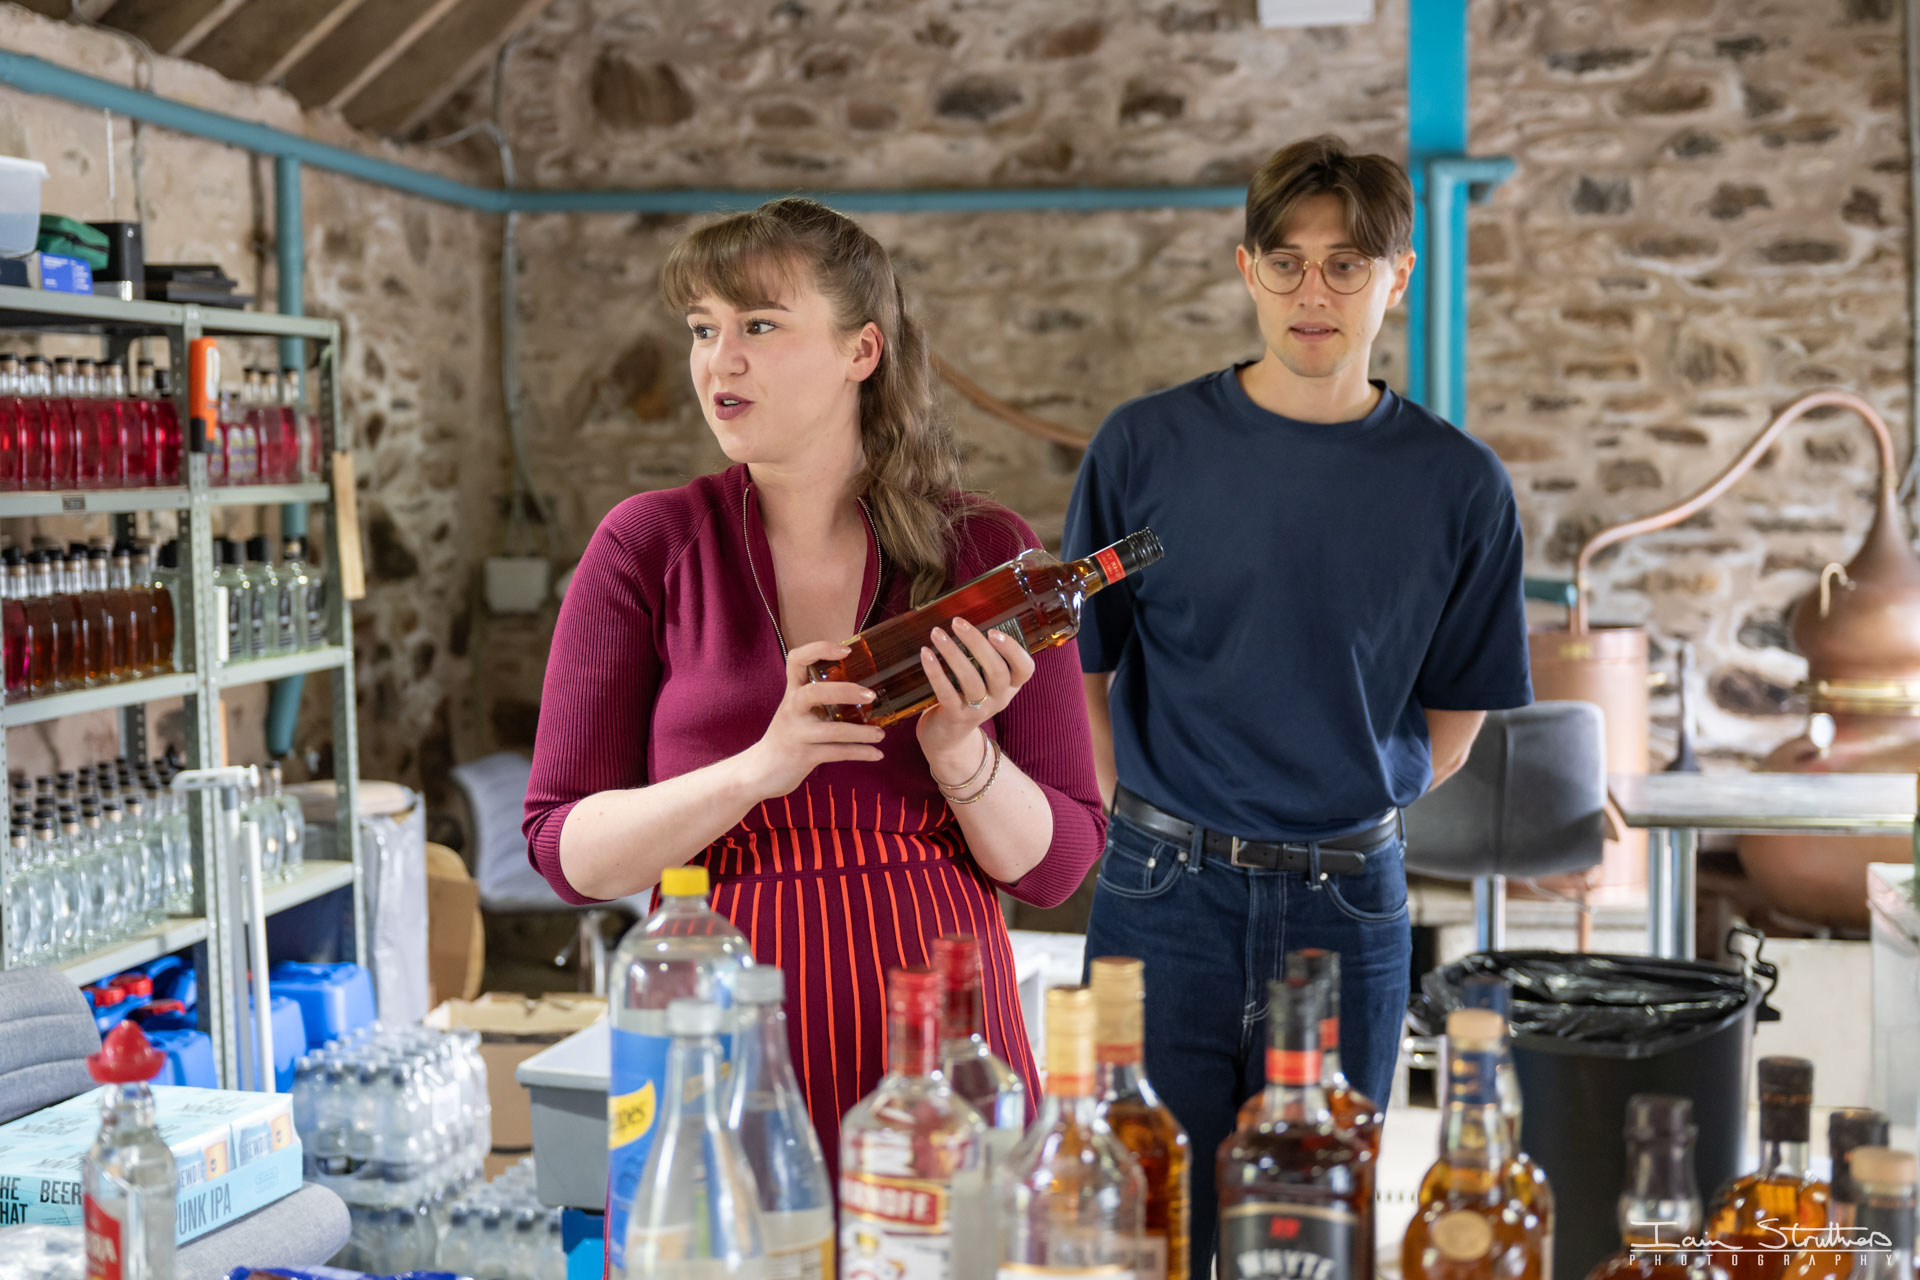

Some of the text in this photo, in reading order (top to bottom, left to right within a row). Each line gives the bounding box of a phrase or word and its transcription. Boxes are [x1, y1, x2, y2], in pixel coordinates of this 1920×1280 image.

[40, 1179, 82, 1206] BEER
[177, 1182, 232, 1236] UNK IPA
